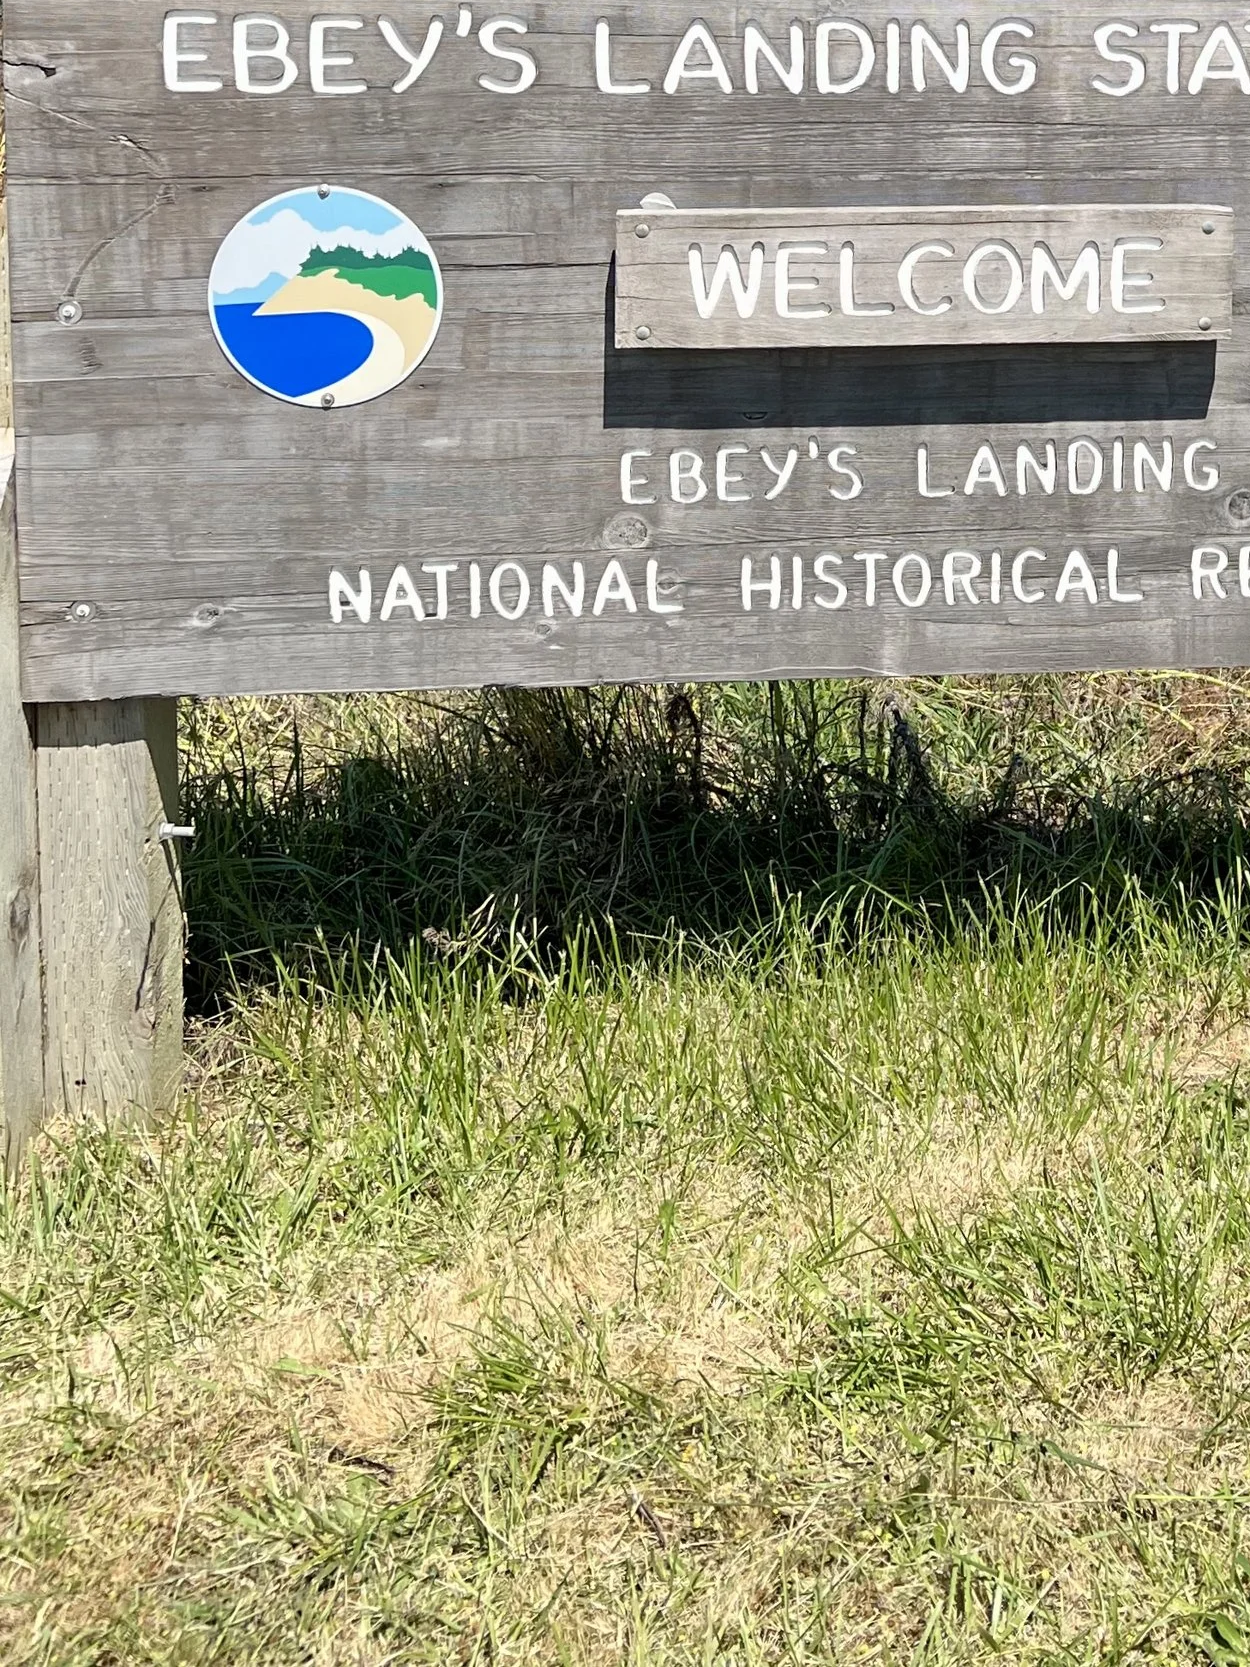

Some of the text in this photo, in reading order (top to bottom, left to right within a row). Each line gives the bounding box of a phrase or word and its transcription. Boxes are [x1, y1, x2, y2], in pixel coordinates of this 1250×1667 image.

[162, 4, 539, 94] EBEY'S
[594, 17, 1038, 95] LANDING
[687, 238, 1167, 320] WELCOME
[619, 436, 1222, 506] EBEY'S LANDING
[328, 557, 685, 623] NATIONAL
[740, 546, 1145, 612] HISTORICAL
